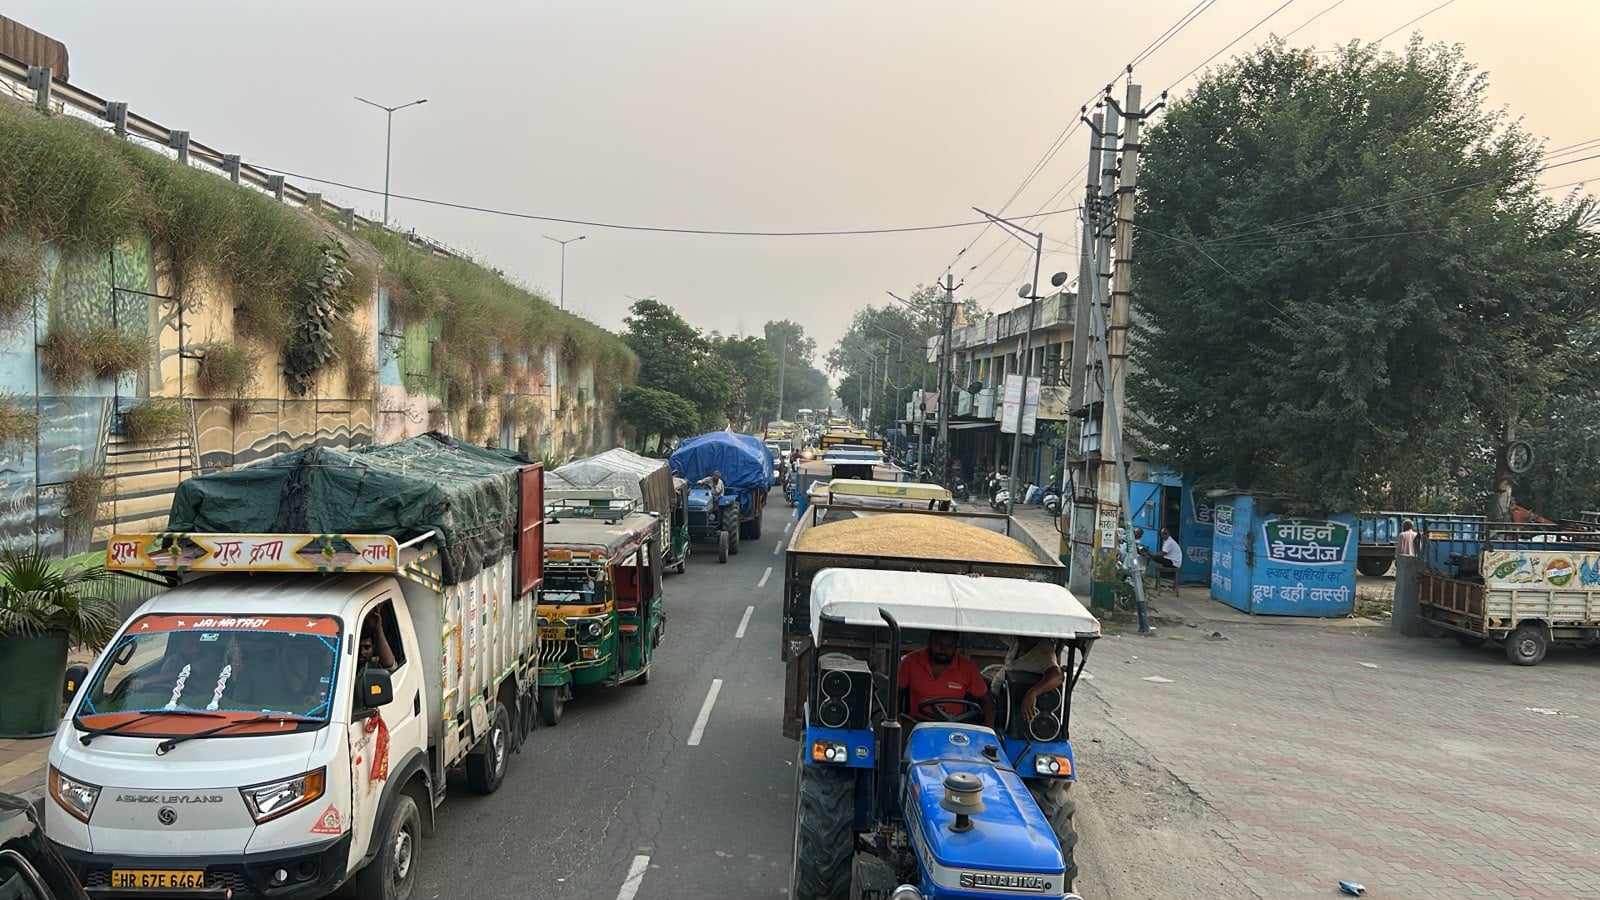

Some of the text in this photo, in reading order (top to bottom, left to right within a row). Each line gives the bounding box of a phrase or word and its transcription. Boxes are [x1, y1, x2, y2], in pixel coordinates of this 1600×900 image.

[1277, 520, 1335, 541] मॉडर्न
[112, 541, 140, 564] शुभ
[213, 541, 242, 566] गुरु
[361, 544, 391, 564] लाभ
[1253, 584, 1276, 604] दूध
[1280, 582, 1307, 603] दही
[1310, 585, 1350, 602] लस्सी
[116, 794, 223, 804] ASHOK LEYLAND
[120, 873, 203, 889] HR 67E 6464
[960, 872, 1044, 891] SONALIKA
